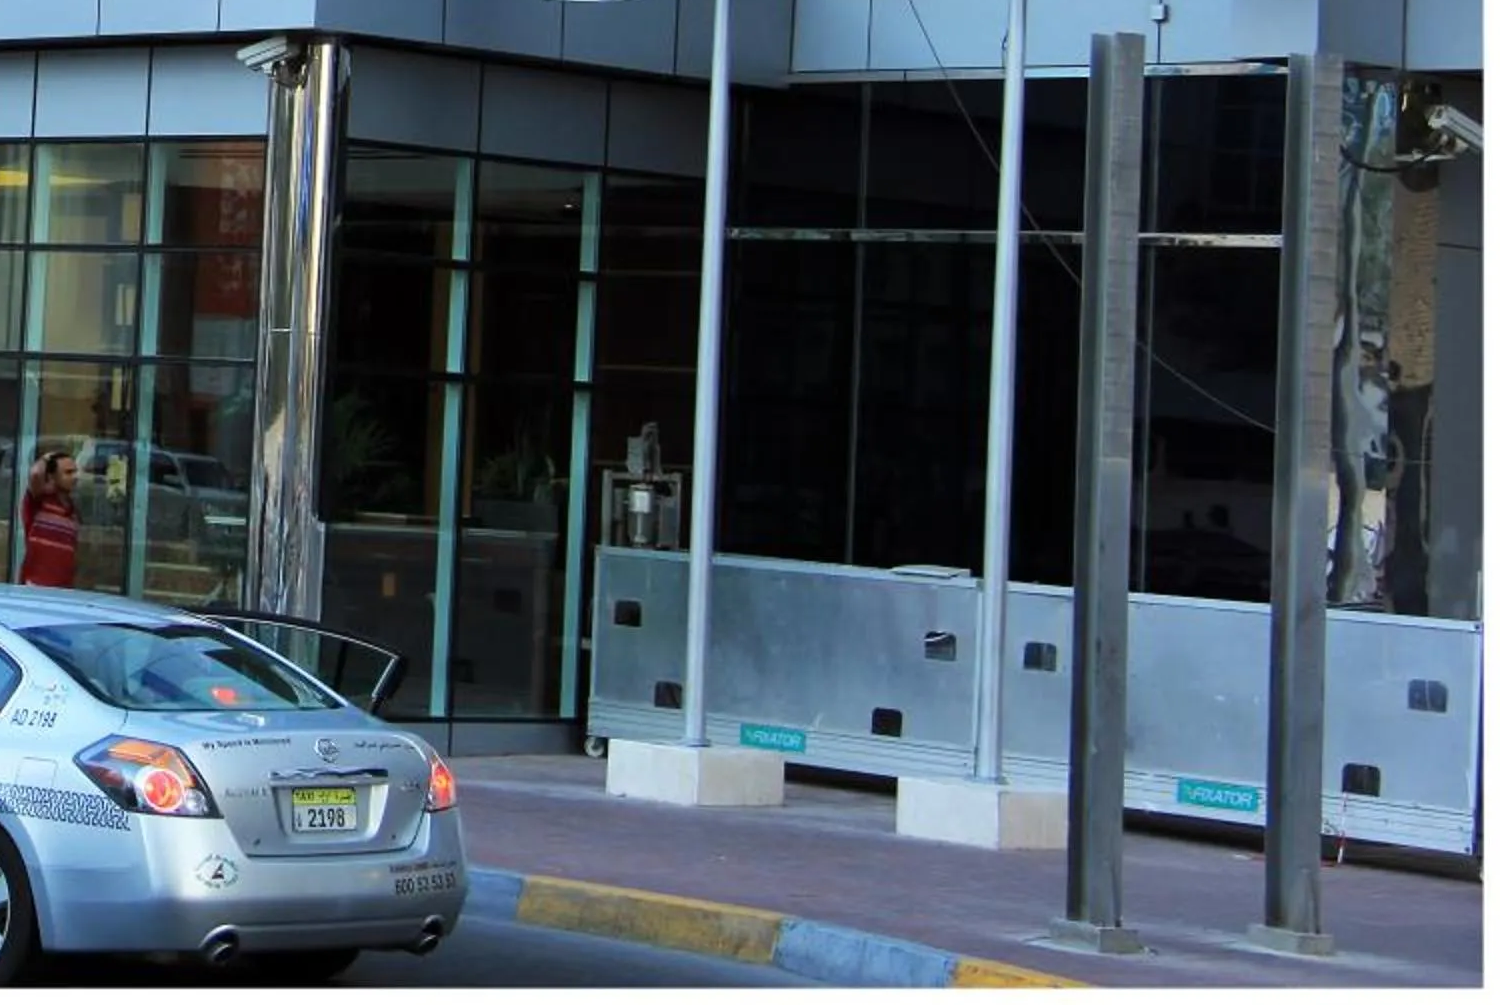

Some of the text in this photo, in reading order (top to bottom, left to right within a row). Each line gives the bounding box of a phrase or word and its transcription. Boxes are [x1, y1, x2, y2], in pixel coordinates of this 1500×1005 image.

[29, 710, 58, 728] 2198
[1189, 786, 1254, 809] FIXATOR
[307, 807, 346, 828] 2198
